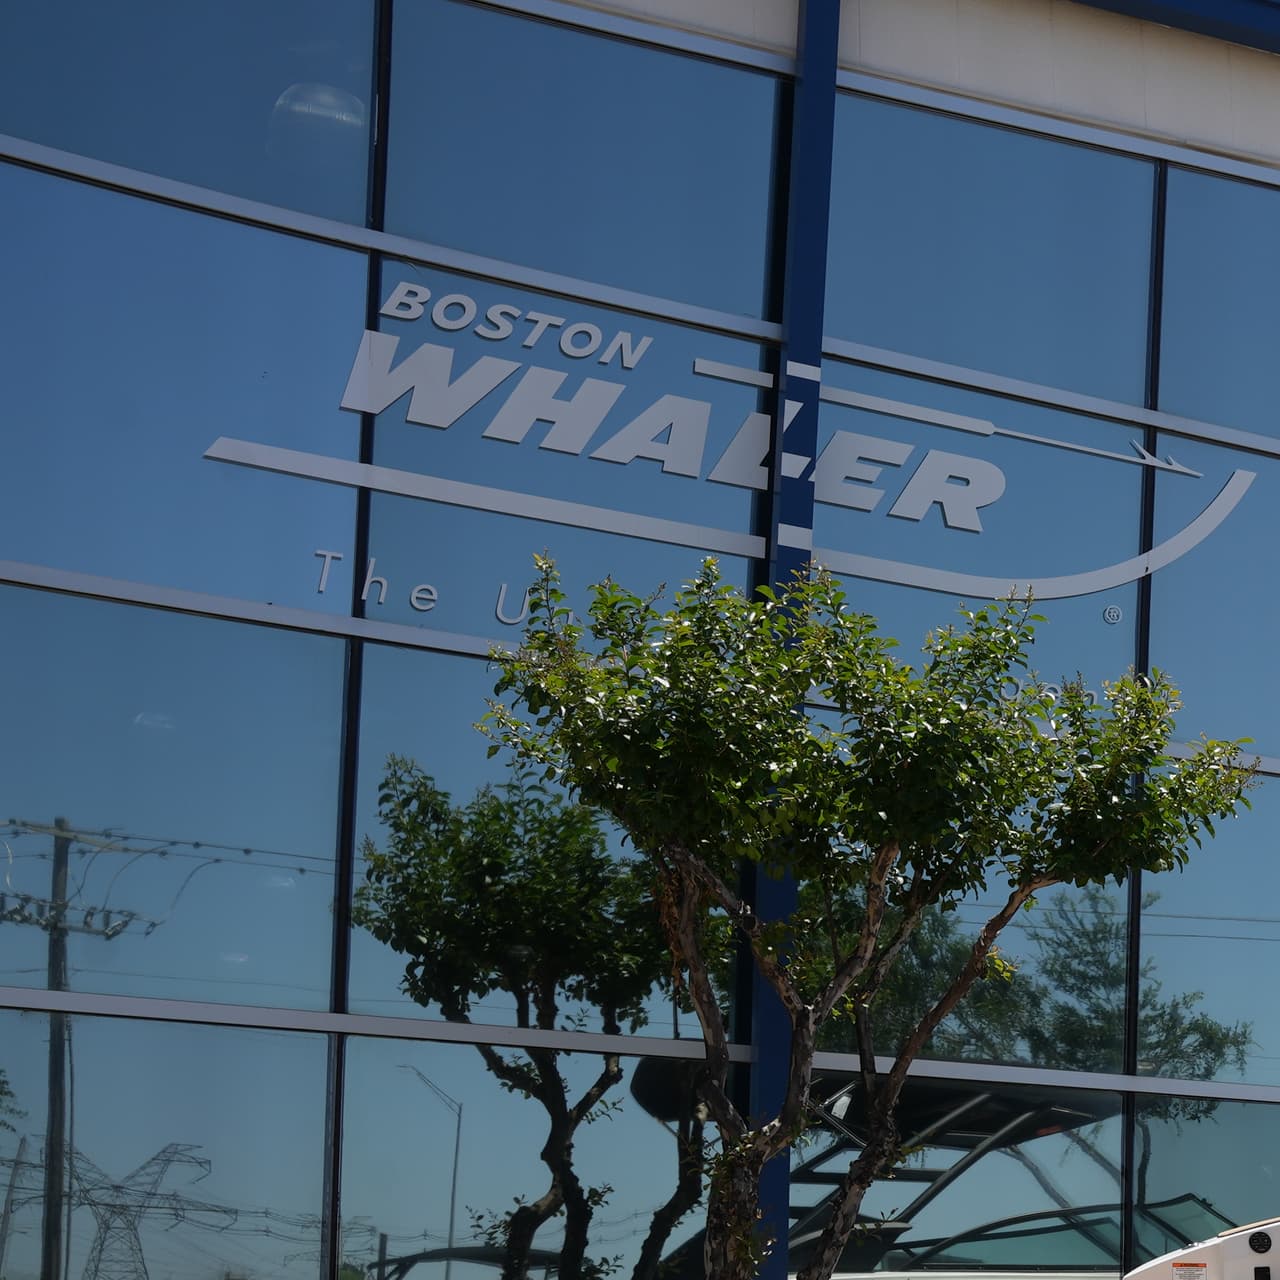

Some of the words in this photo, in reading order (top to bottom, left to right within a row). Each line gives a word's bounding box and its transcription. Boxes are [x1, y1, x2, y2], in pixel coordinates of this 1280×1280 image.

[379, 280, 653, 370] BOSTON
[339, 328, 1007, 534] WHALER
[314, 549, 439, 613] The
